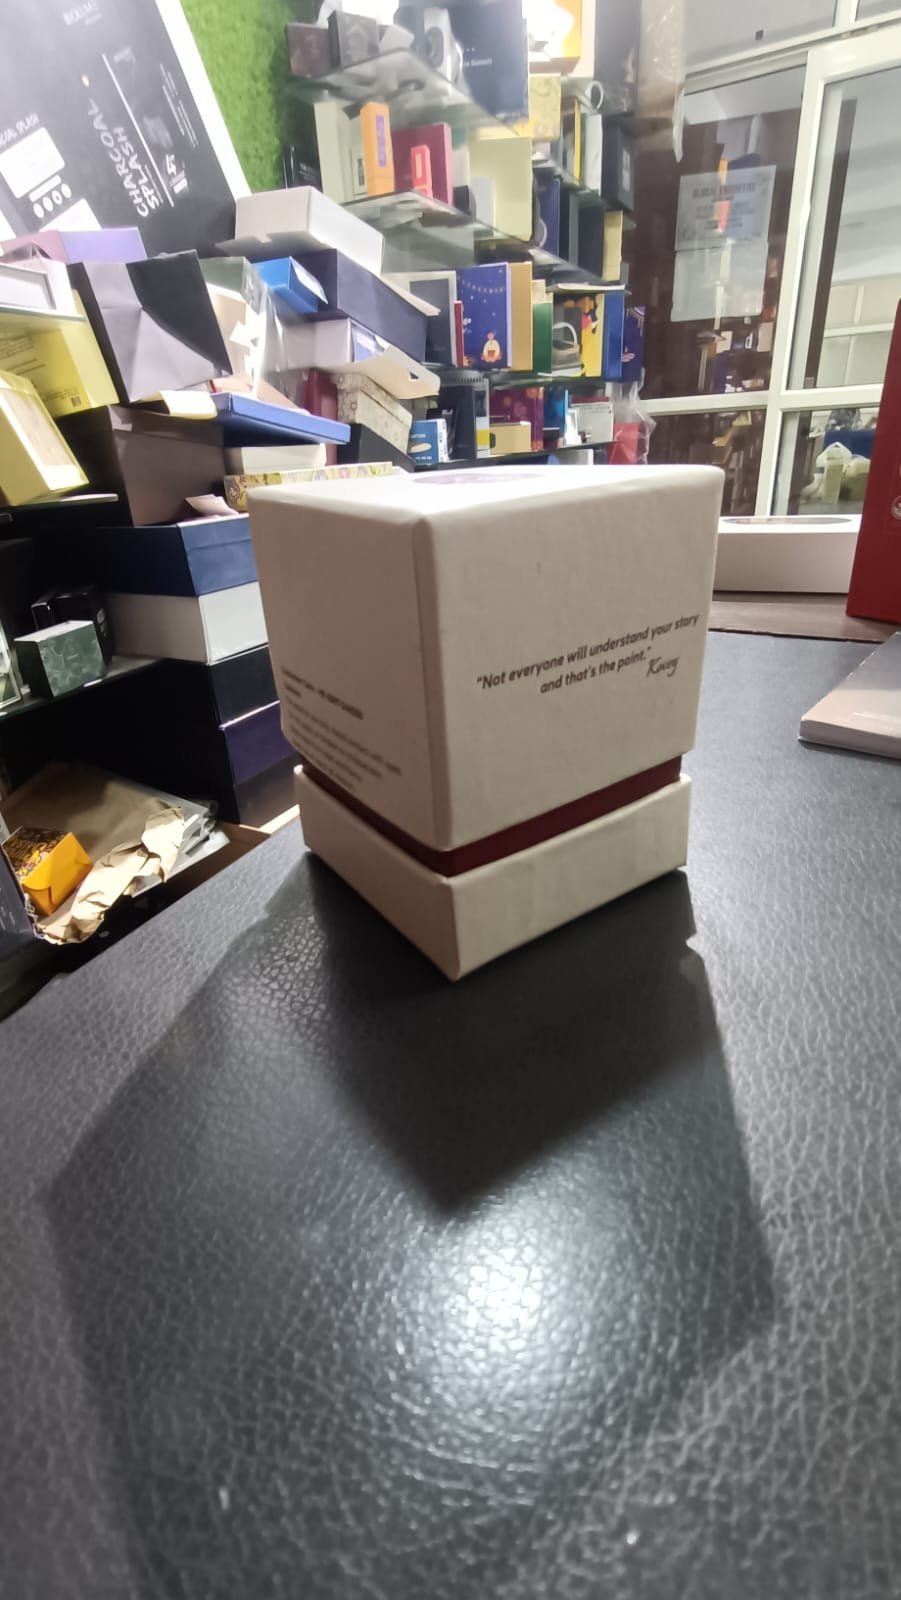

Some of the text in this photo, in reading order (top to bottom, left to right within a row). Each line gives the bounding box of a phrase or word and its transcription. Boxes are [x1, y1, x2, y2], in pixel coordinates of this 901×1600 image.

[87, 97, 149, 217] CHARCOAL
[113, 126, 160, 210] SPLASH
[509, 655, 565, 682] everyone
[567, 646, 588, 665] will
[590, 627, 650, 657] understand
[651, 622, 674, 641] your
[674, 614, 699, 631] story
[540, 675, 563, 694] and
[565, 664, 597, 686] that's
[599, 660, 616, 676] the
